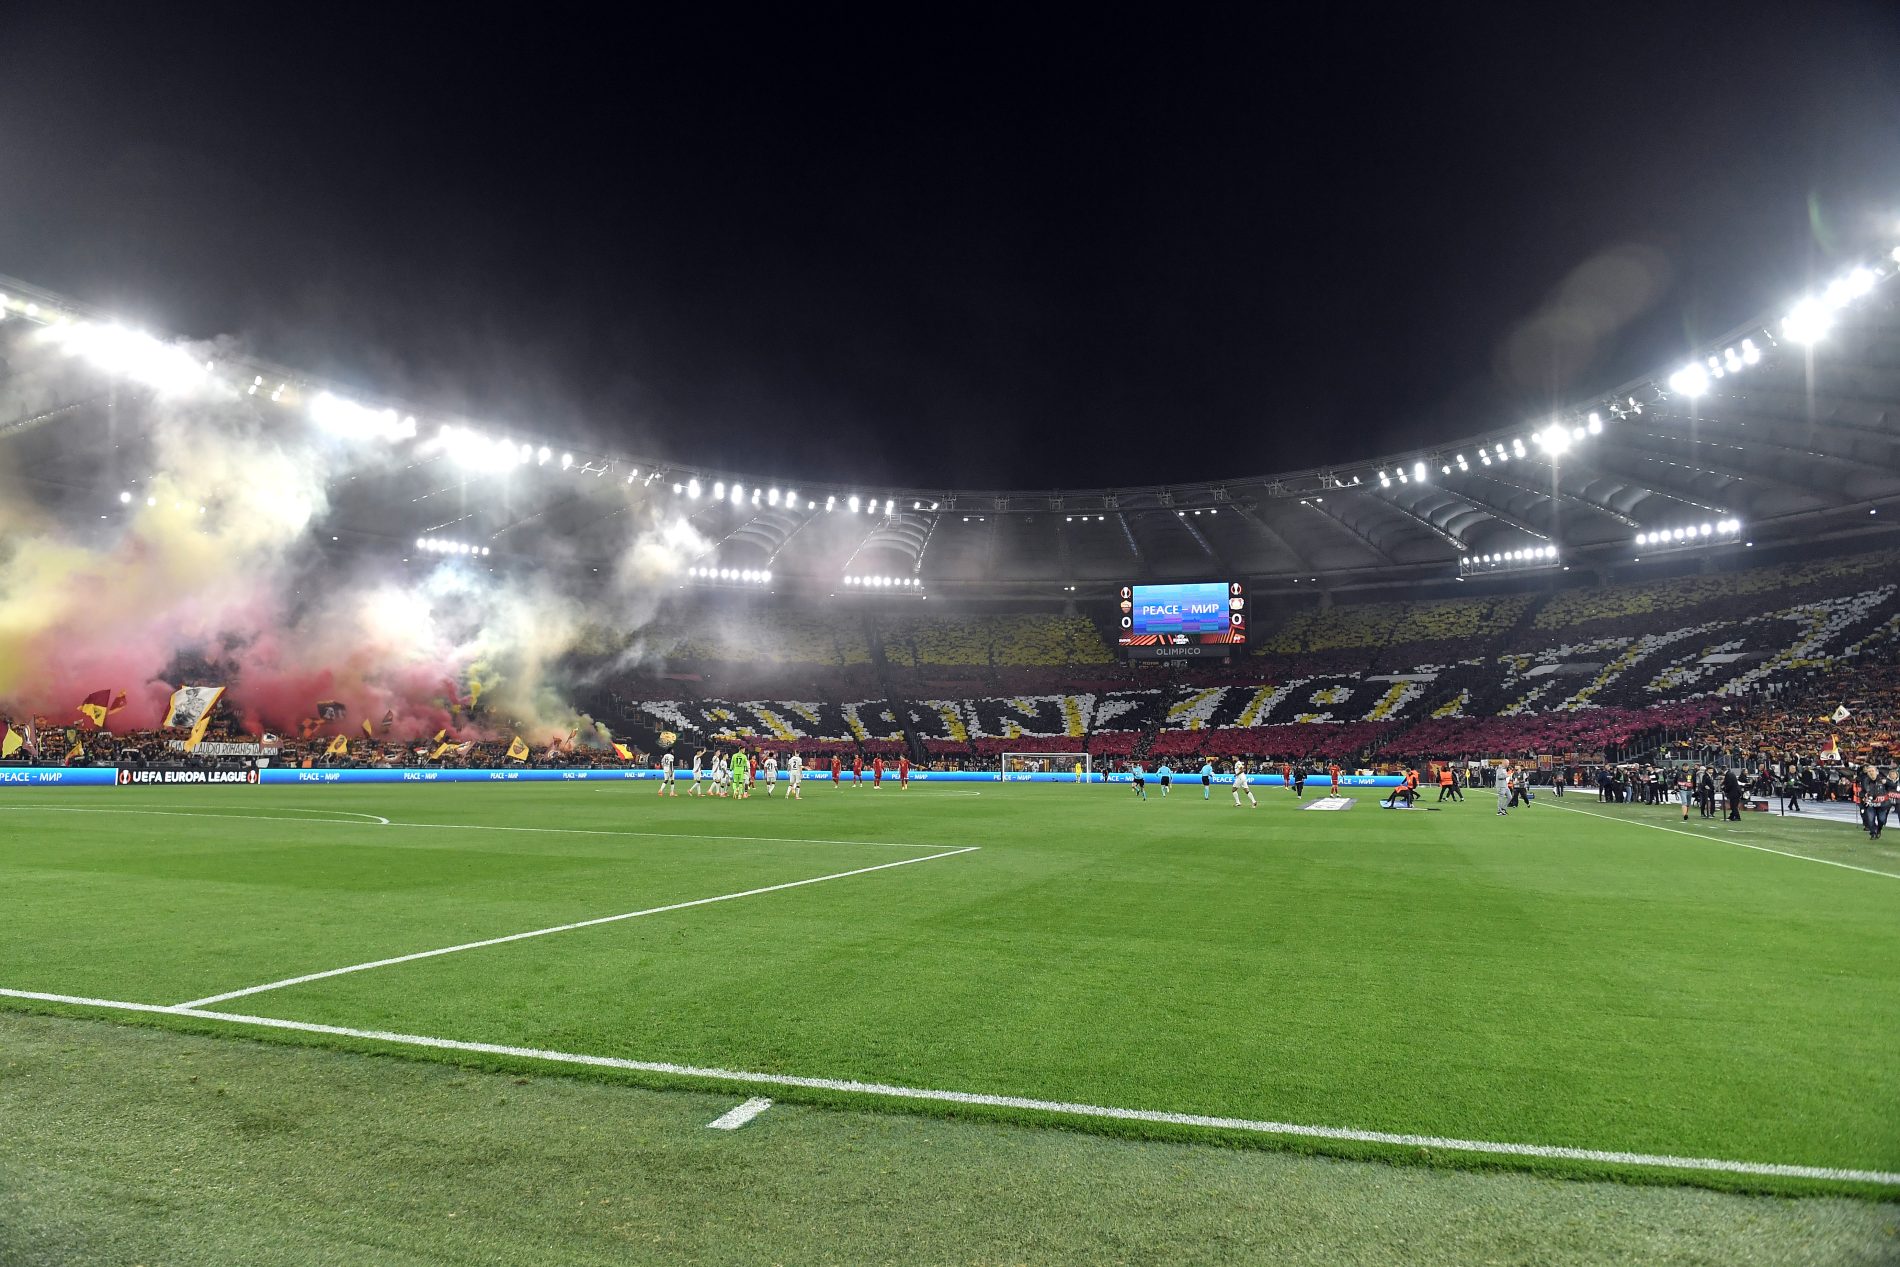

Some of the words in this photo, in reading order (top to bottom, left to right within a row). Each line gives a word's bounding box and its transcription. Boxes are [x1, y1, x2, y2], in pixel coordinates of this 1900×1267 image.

[1143, 605, 1179, 615] PEACE
[1191, 604, 1219, 614] МИР
[1121, 616, 1132, 628] 0
[1231, 613, 1242, 625] 0
[1156, 647, 1201, 656] OLIMPICO
[0, 772, 29, 782] PEACE
[40, 772, 62, 782] МИР
[132, 771, 162, 782] UEFA
[165, 771, 206, 782] EUROPA
[209, 771, 247, 782] LEAGUE
[299, 772, 319, 780] PEACE
[325, 772, 340, 780] МИР
